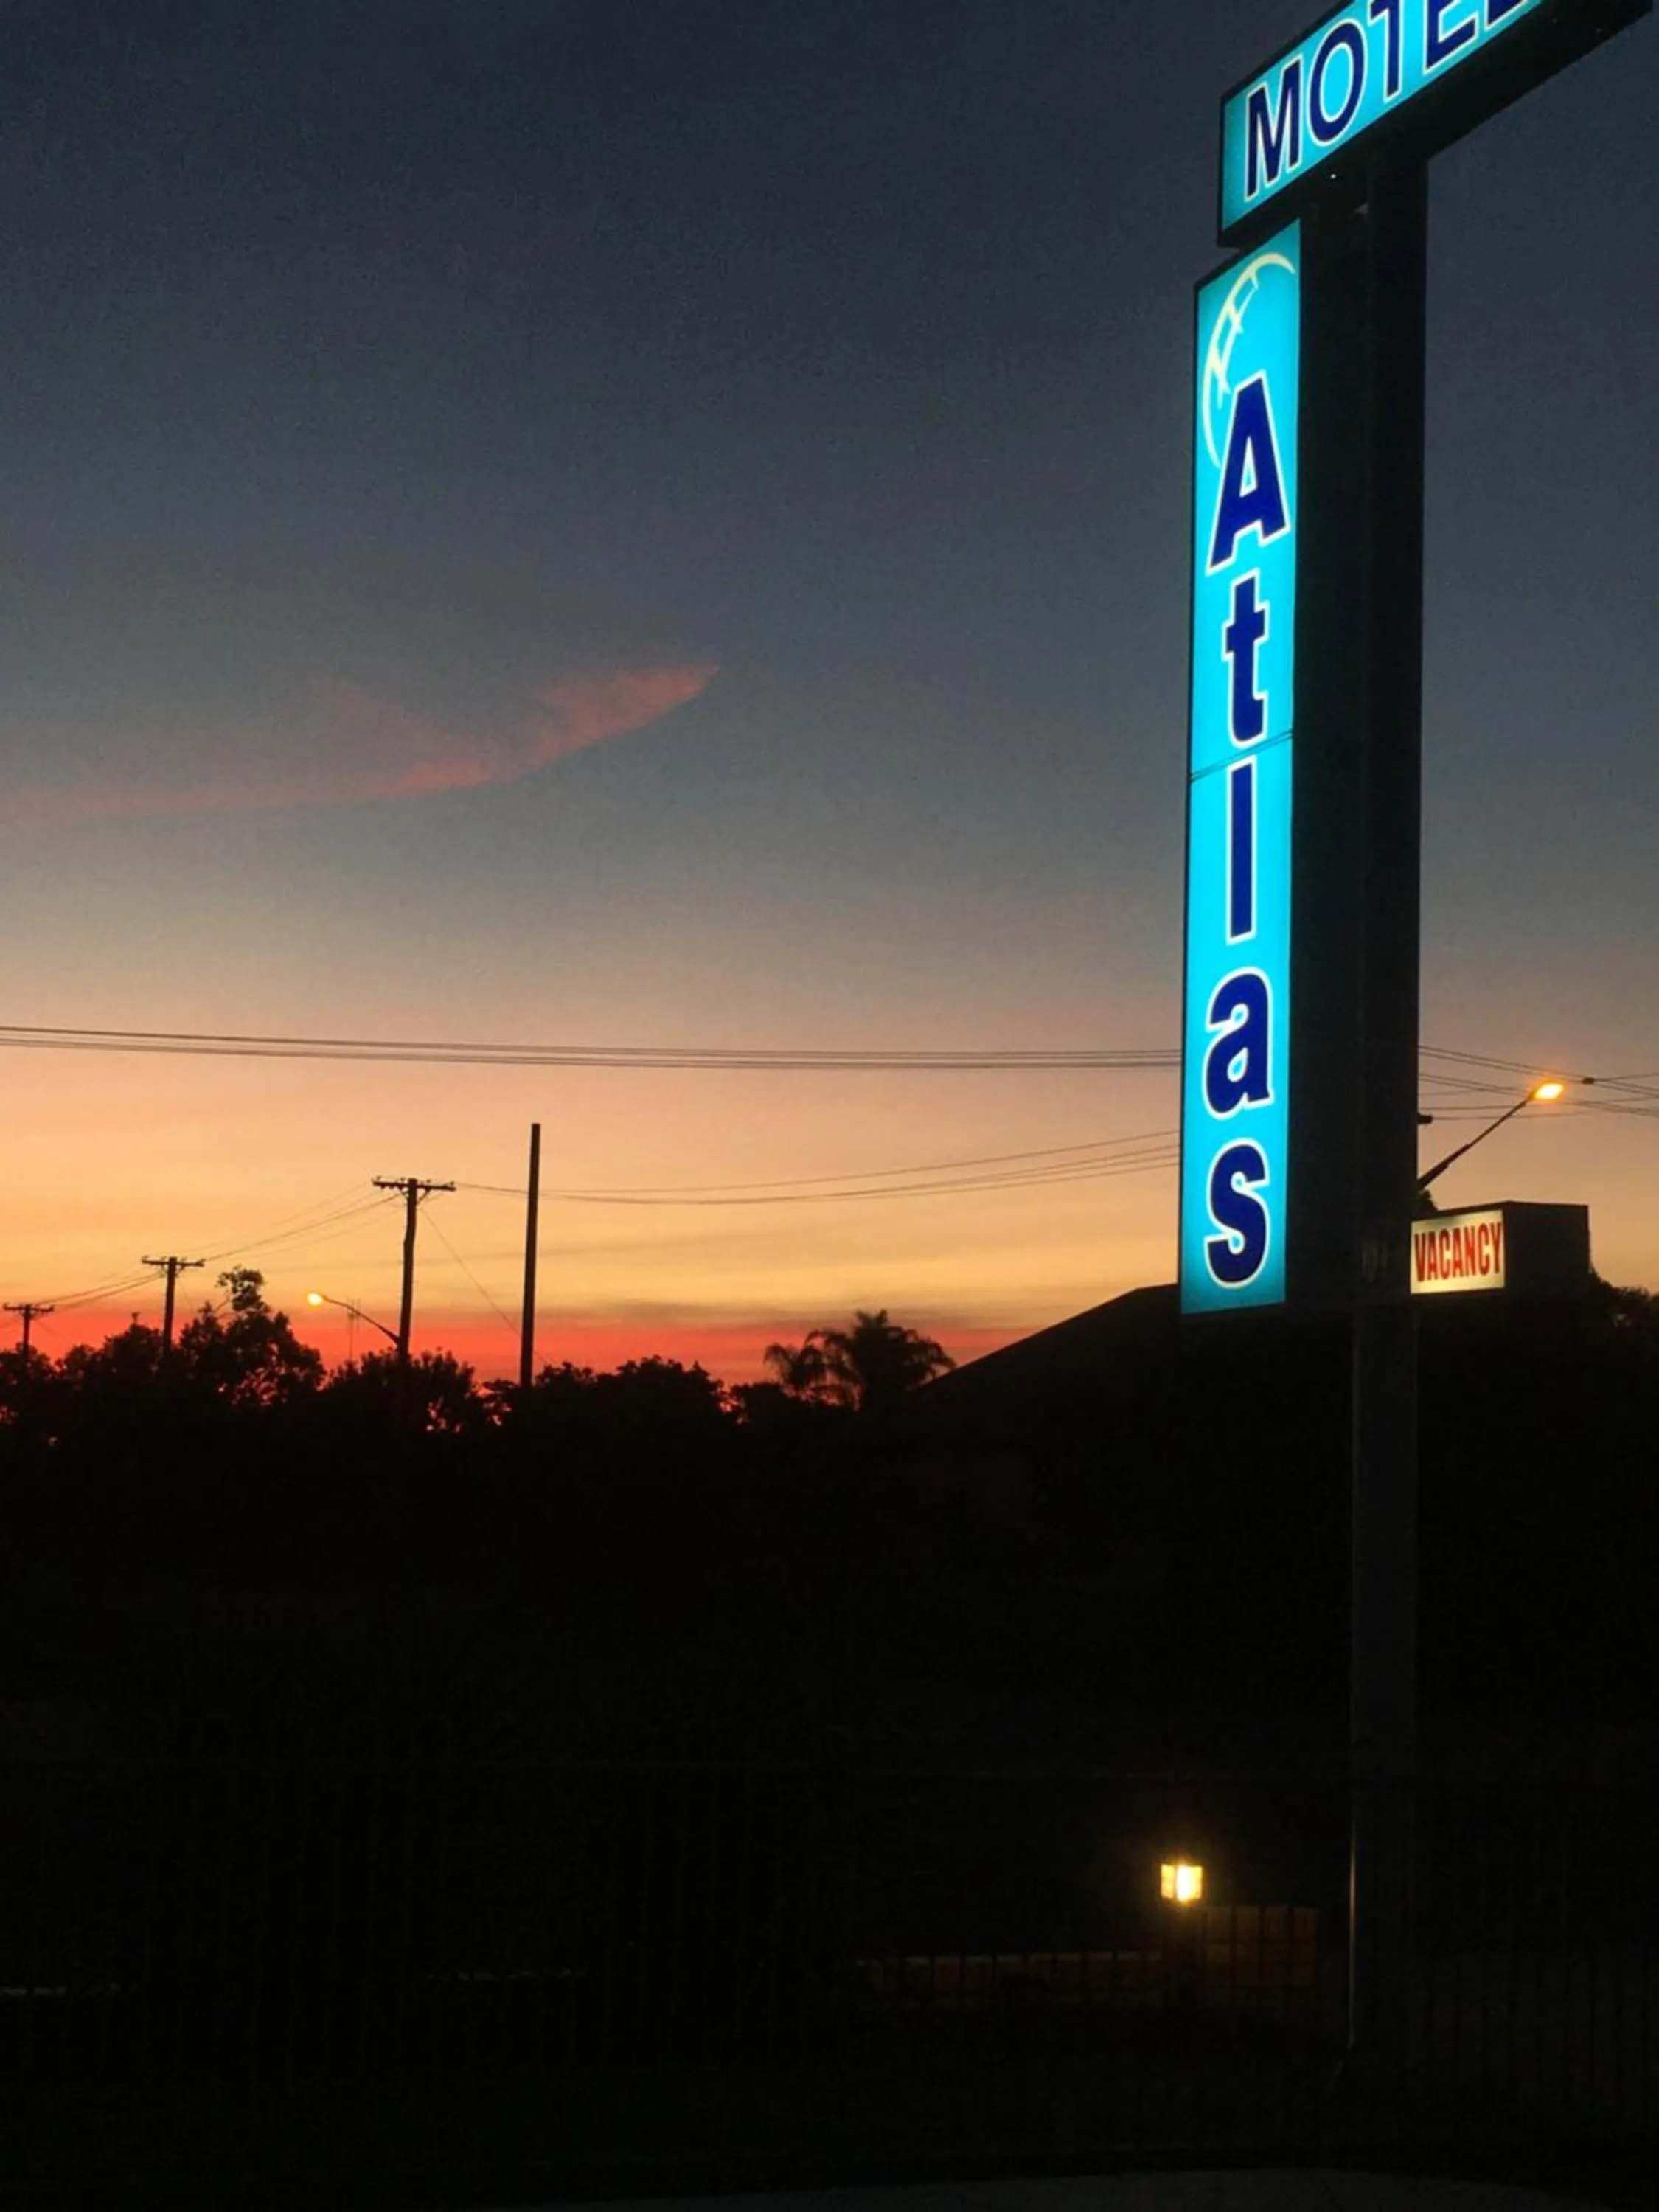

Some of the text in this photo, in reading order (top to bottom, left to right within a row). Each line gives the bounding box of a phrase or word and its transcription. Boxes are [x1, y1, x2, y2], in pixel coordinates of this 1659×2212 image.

[1244, 0, 1526, 201] MOTE
[1203, 371, 1291, 1289] Atlas
[1413, 1222, 1502, 1281] VACANCY
